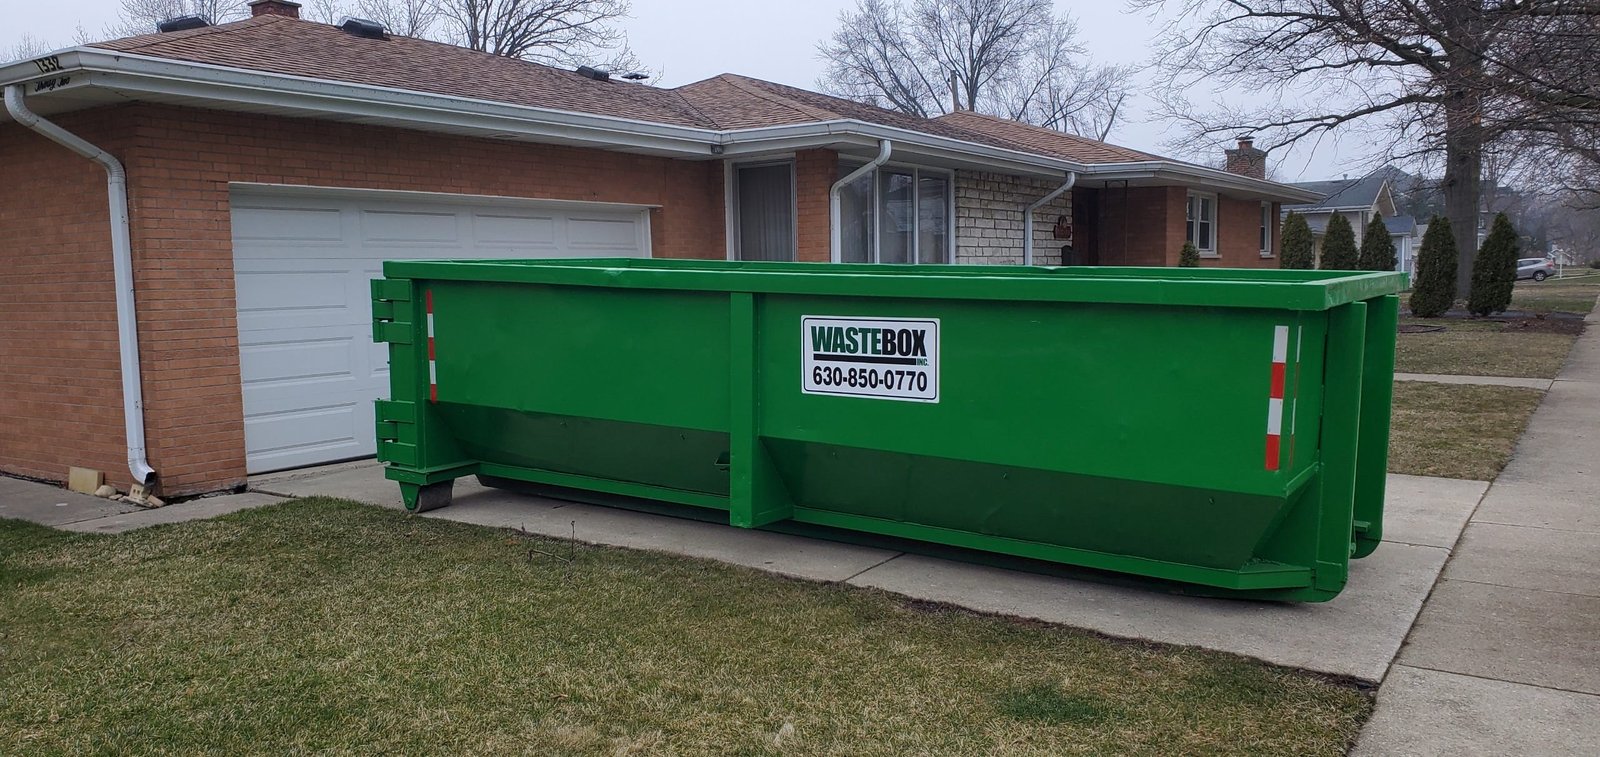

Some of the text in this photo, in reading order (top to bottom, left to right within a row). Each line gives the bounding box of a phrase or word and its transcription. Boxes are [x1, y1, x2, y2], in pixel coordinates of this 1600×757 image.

[32, 55, 63, 73] 1332
[811, 326, 927, 357] WASTEBOX
[812, 365, 928, 392] 630-850-0770
